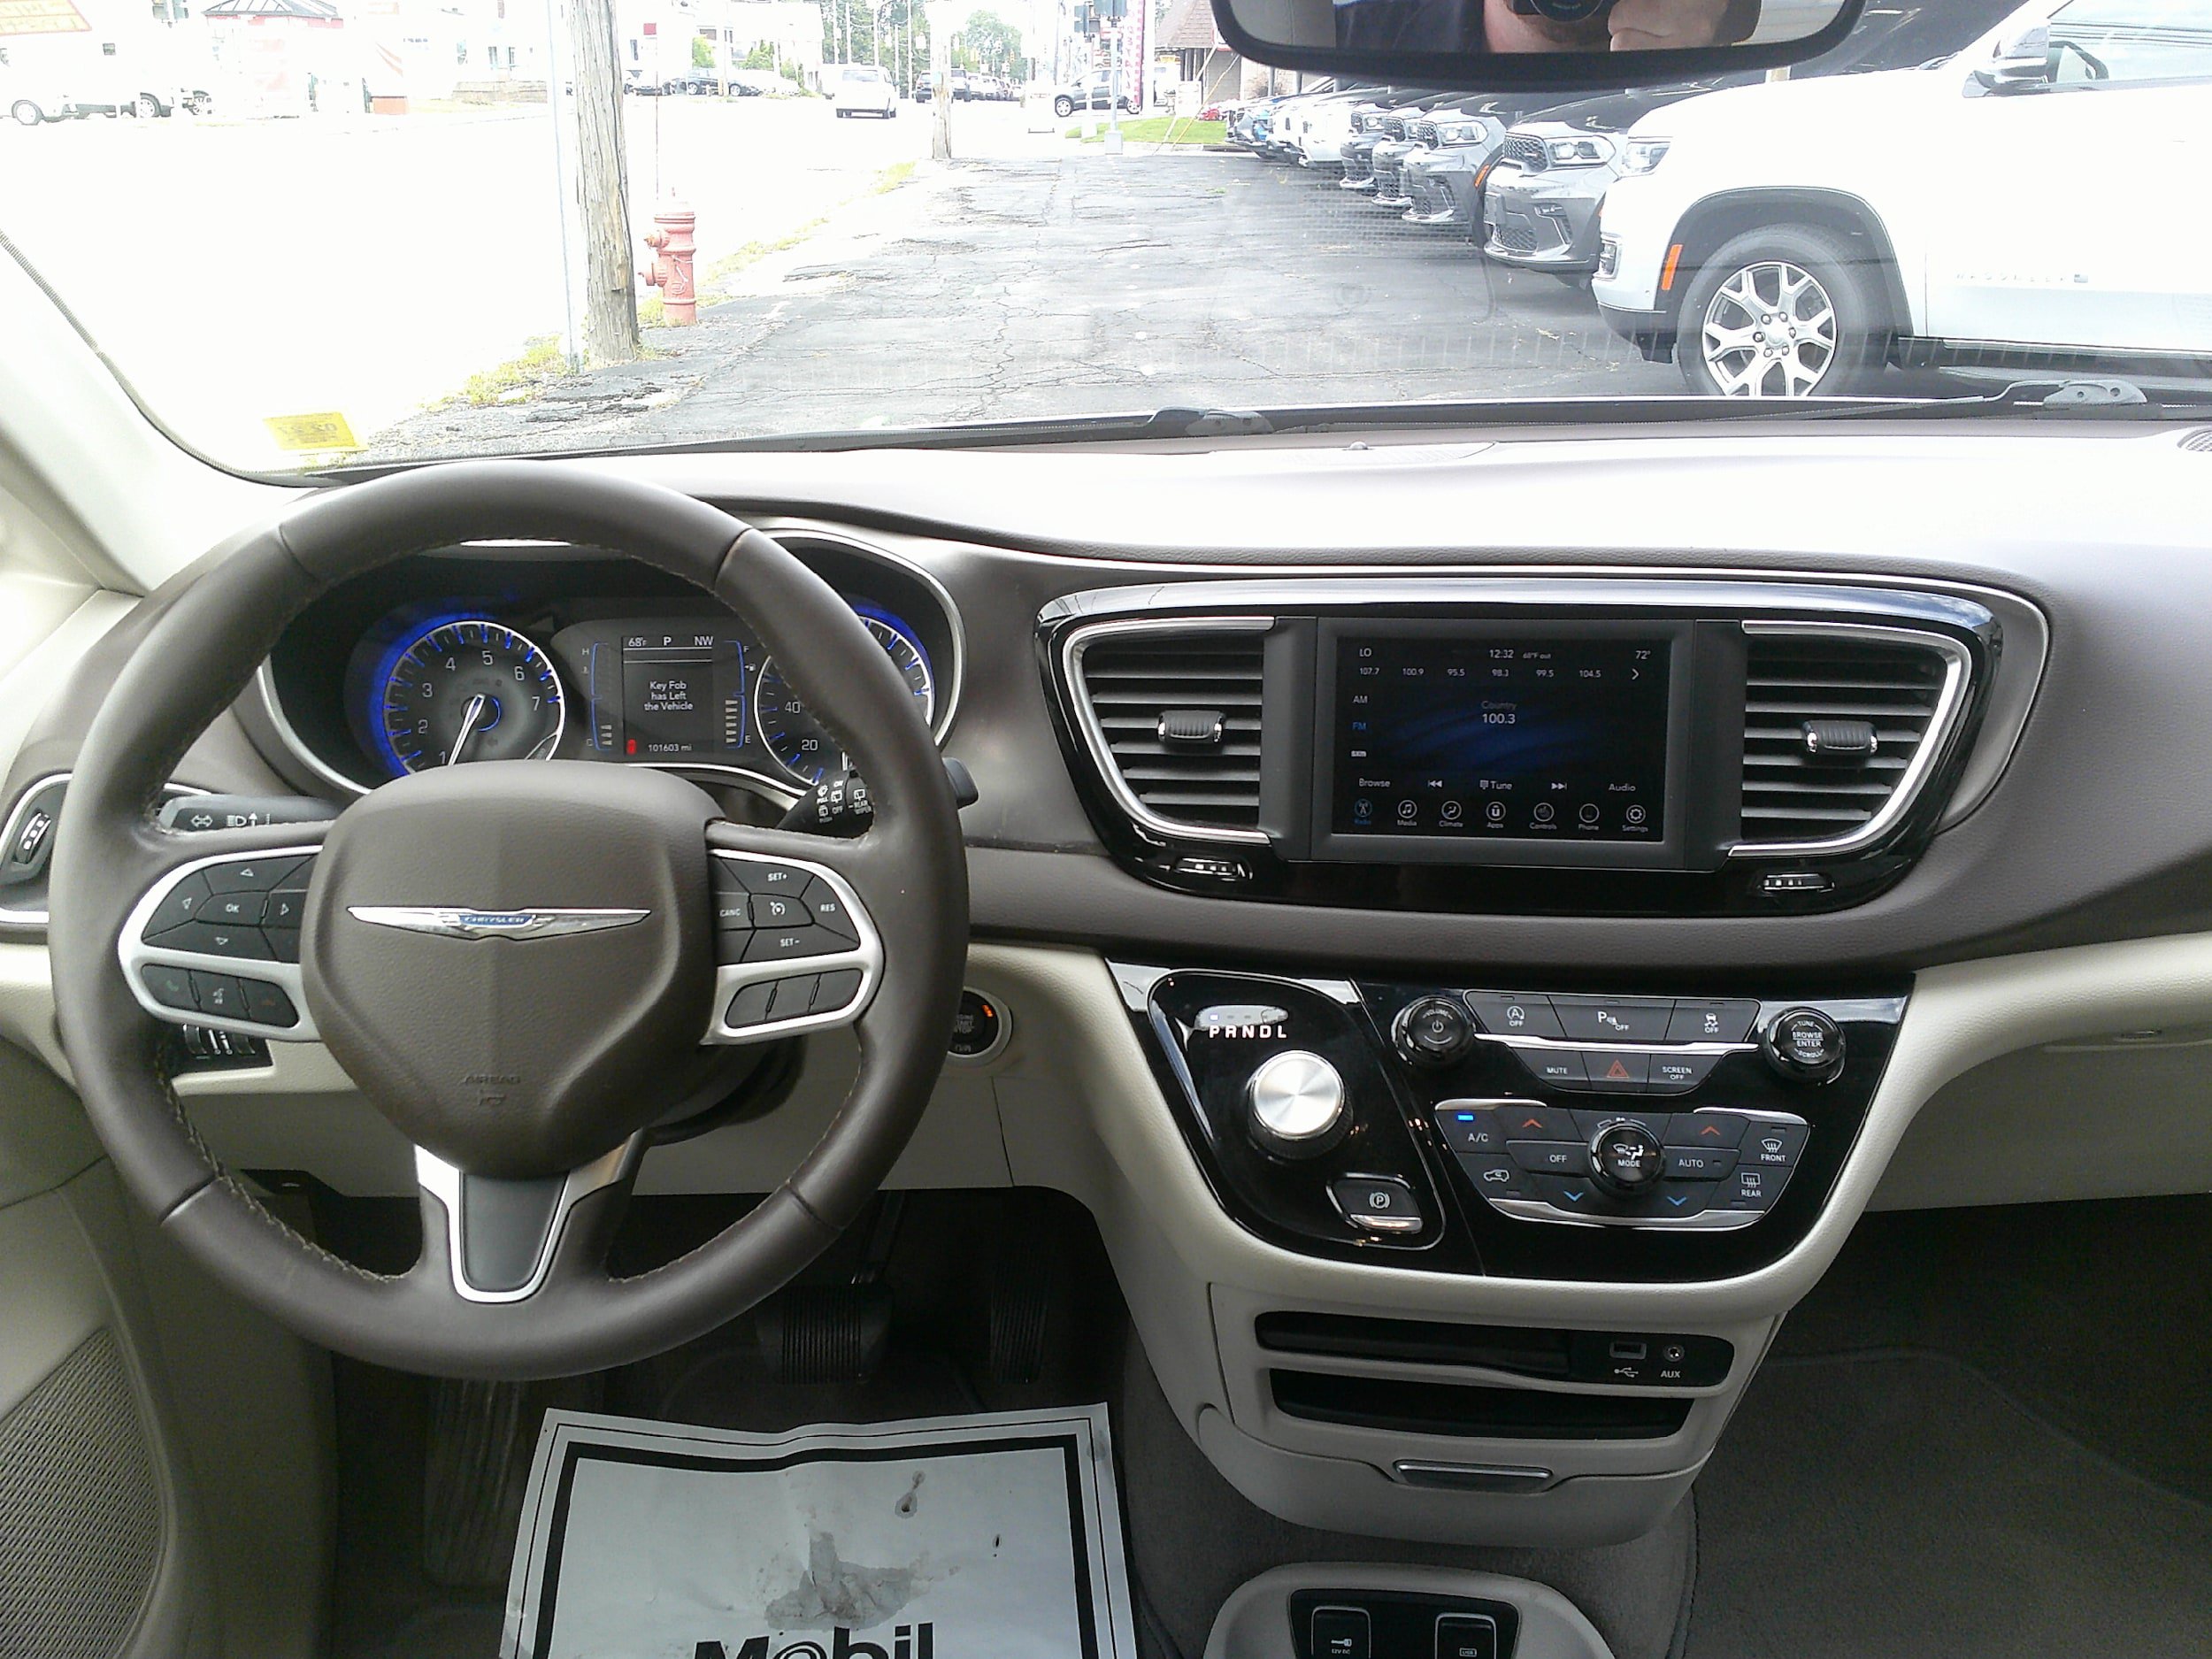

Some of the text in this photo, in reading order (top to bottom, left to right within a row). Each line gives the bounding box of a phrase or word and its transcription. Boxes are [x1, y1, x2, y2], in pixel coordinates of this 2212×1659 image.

[663, 637, 672, 646] P
[695, 636, 713, 646] NW
[1359, 648, 1371, 657] LO
[1635, 650, 1651, 659] 72°
[481, 650, 495, 666] 5
[445, 657, 457, 672] 4
[513, 666, 526, 681] 6
[1536, 669, 1554, 678] 99.5
[422, 683, 434, 698] 3
[649, 681, 667, 691] Key
[651, 691, 687, 700] has Left
[1352, 695, 1368, 703] AM
[532, 696, 541, 711] 7
[644, 701, 694, 710] the Vehicle
[784, 702, 801, 714] 40
[1482, 713, 1516, 725] 100.3
[418, 719, 428, 734] 2
[1353, 722, 1367, 731] FM
[801, 739, 818, 751] 20
[1358, 778, 1391, 787] Browse
[1490, 780, 1513, 790] Tune
[1609, 783, 1636, 792] Audio
[1622, 825, 1648, 833] Settings
[226, 904, 240, 914] OK
[820, 903, 836, 912] RES
[1663, 1066, 1693, 1075] SCREEN
[1468, 1133, 1488, 1143] A/C
[1549, 1154, 1568, 1163] OFF
[1678, 1158, 1704, 1168] AUTO
[1617, 1159, 1640, 1168] MODE
[1741, 1189, 1762, 1198] REAR
